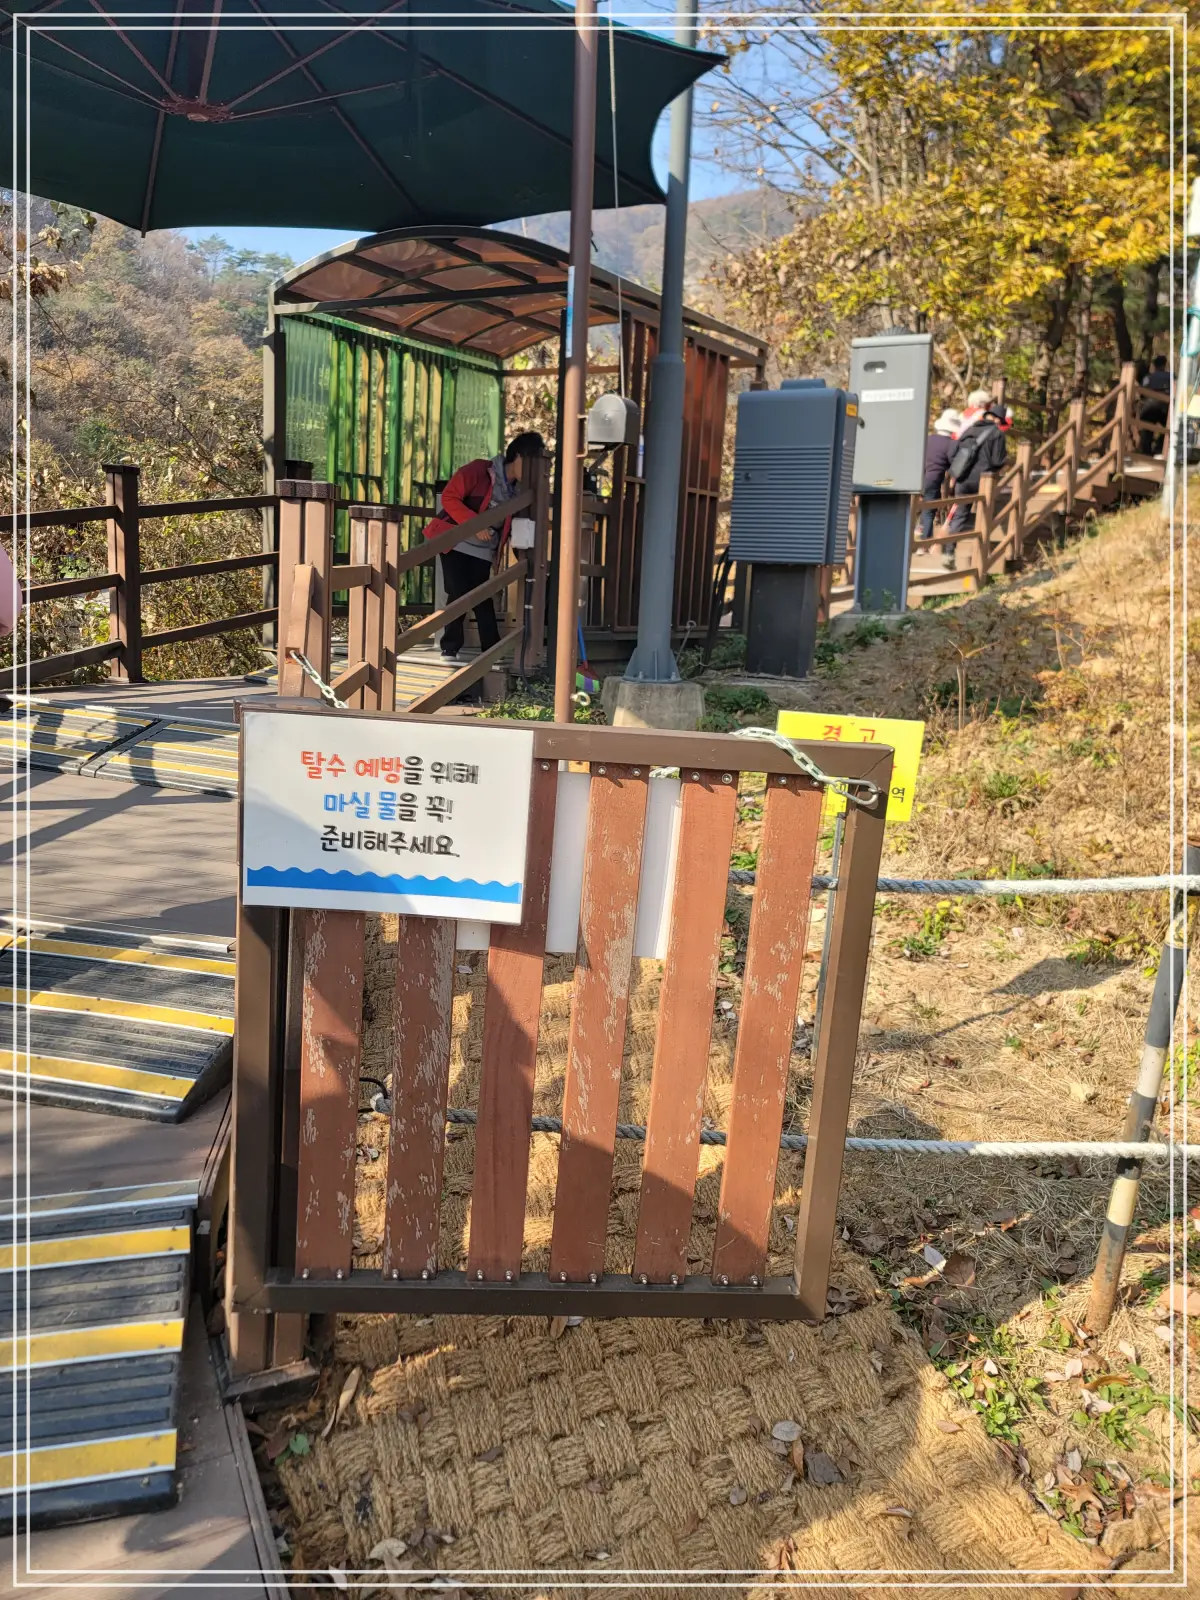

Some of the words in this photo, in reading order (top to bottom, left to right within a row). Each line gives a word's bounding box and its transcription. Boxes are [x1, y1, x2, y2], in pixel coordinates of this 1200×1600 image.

[300, 750, 347, 780] 탈수
[354, 755, 425, 786] 예방을
[430, 760, 480, 785] 위해
[323, 791, 371, 820] 마실
[376, 790, 419, 823] 물을
[424, 794, 454, 824] 꼭!
[320, 824, 460, 858] 준비해주세요.
